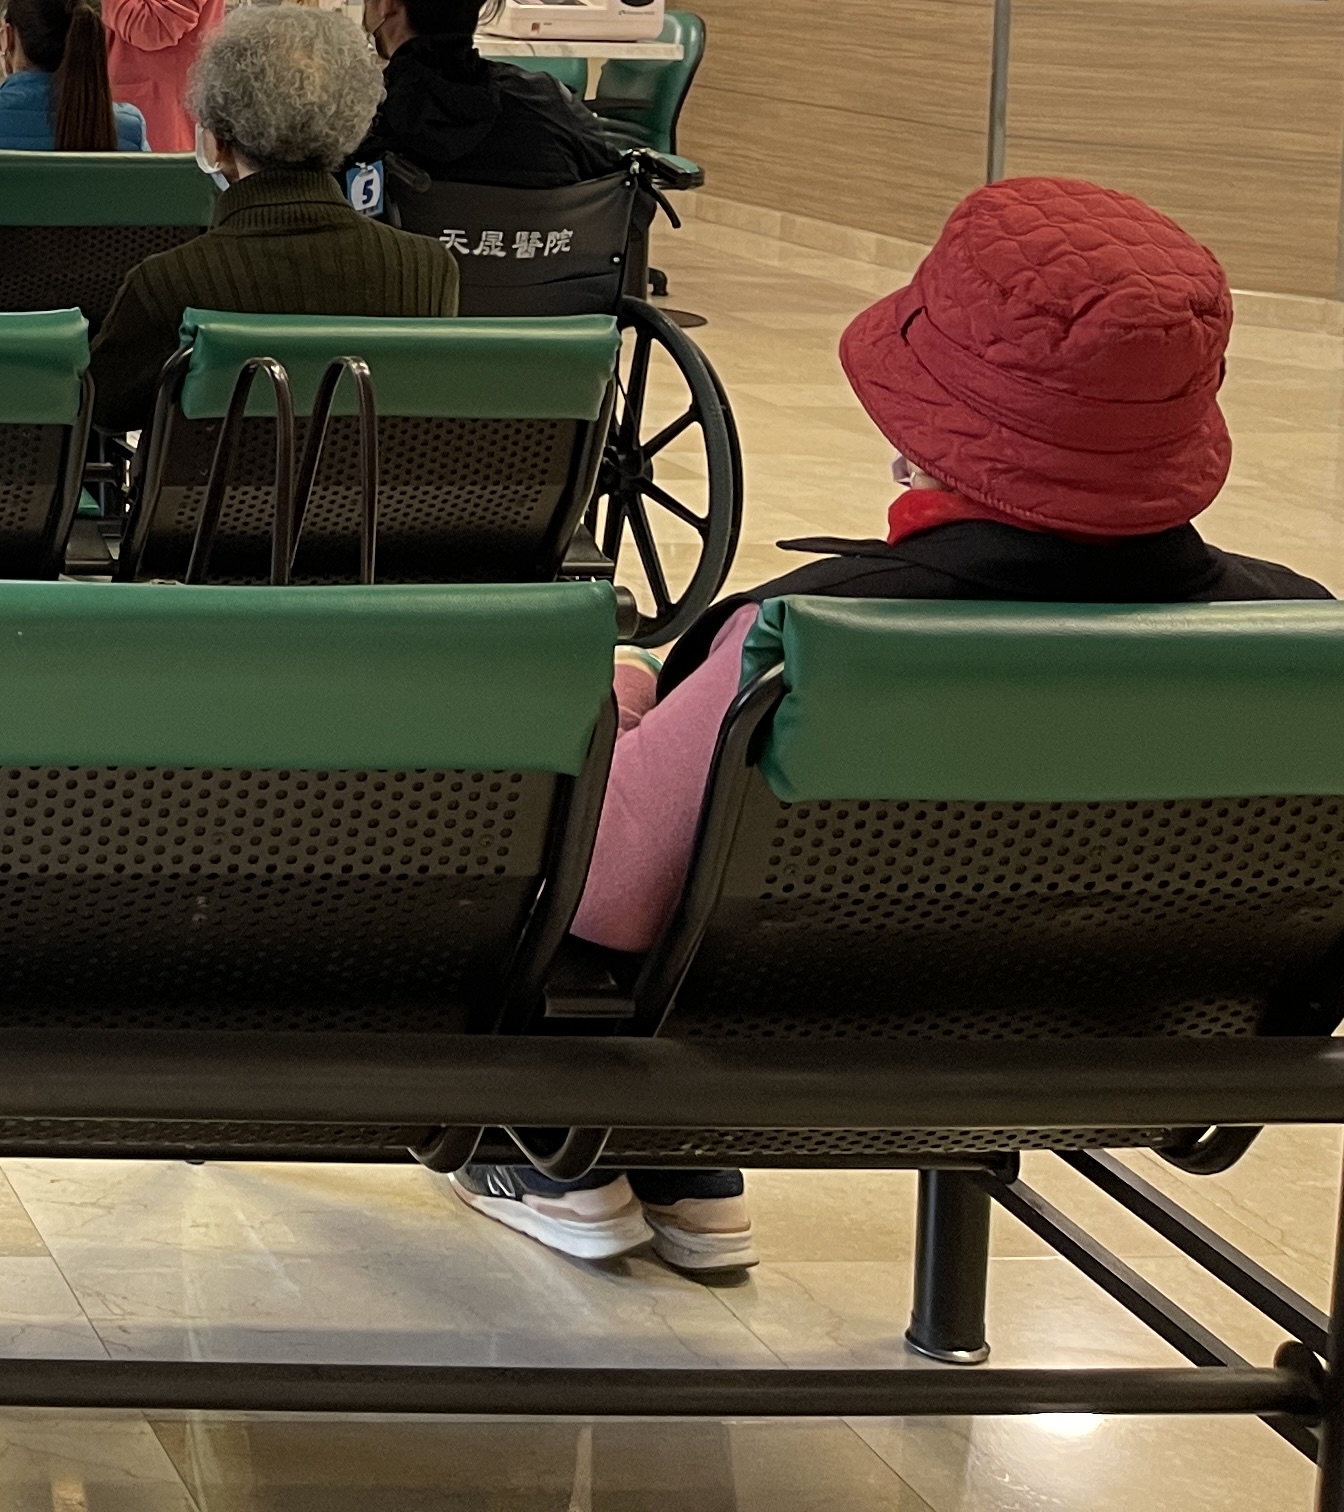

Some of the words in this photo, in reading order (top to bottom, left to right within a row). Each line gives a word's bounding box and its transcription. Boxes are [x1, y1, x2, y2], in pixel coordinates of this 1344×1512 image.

[361, 178, 374, 205] 5
[438, 228, 574, 260] 天晟醫院
